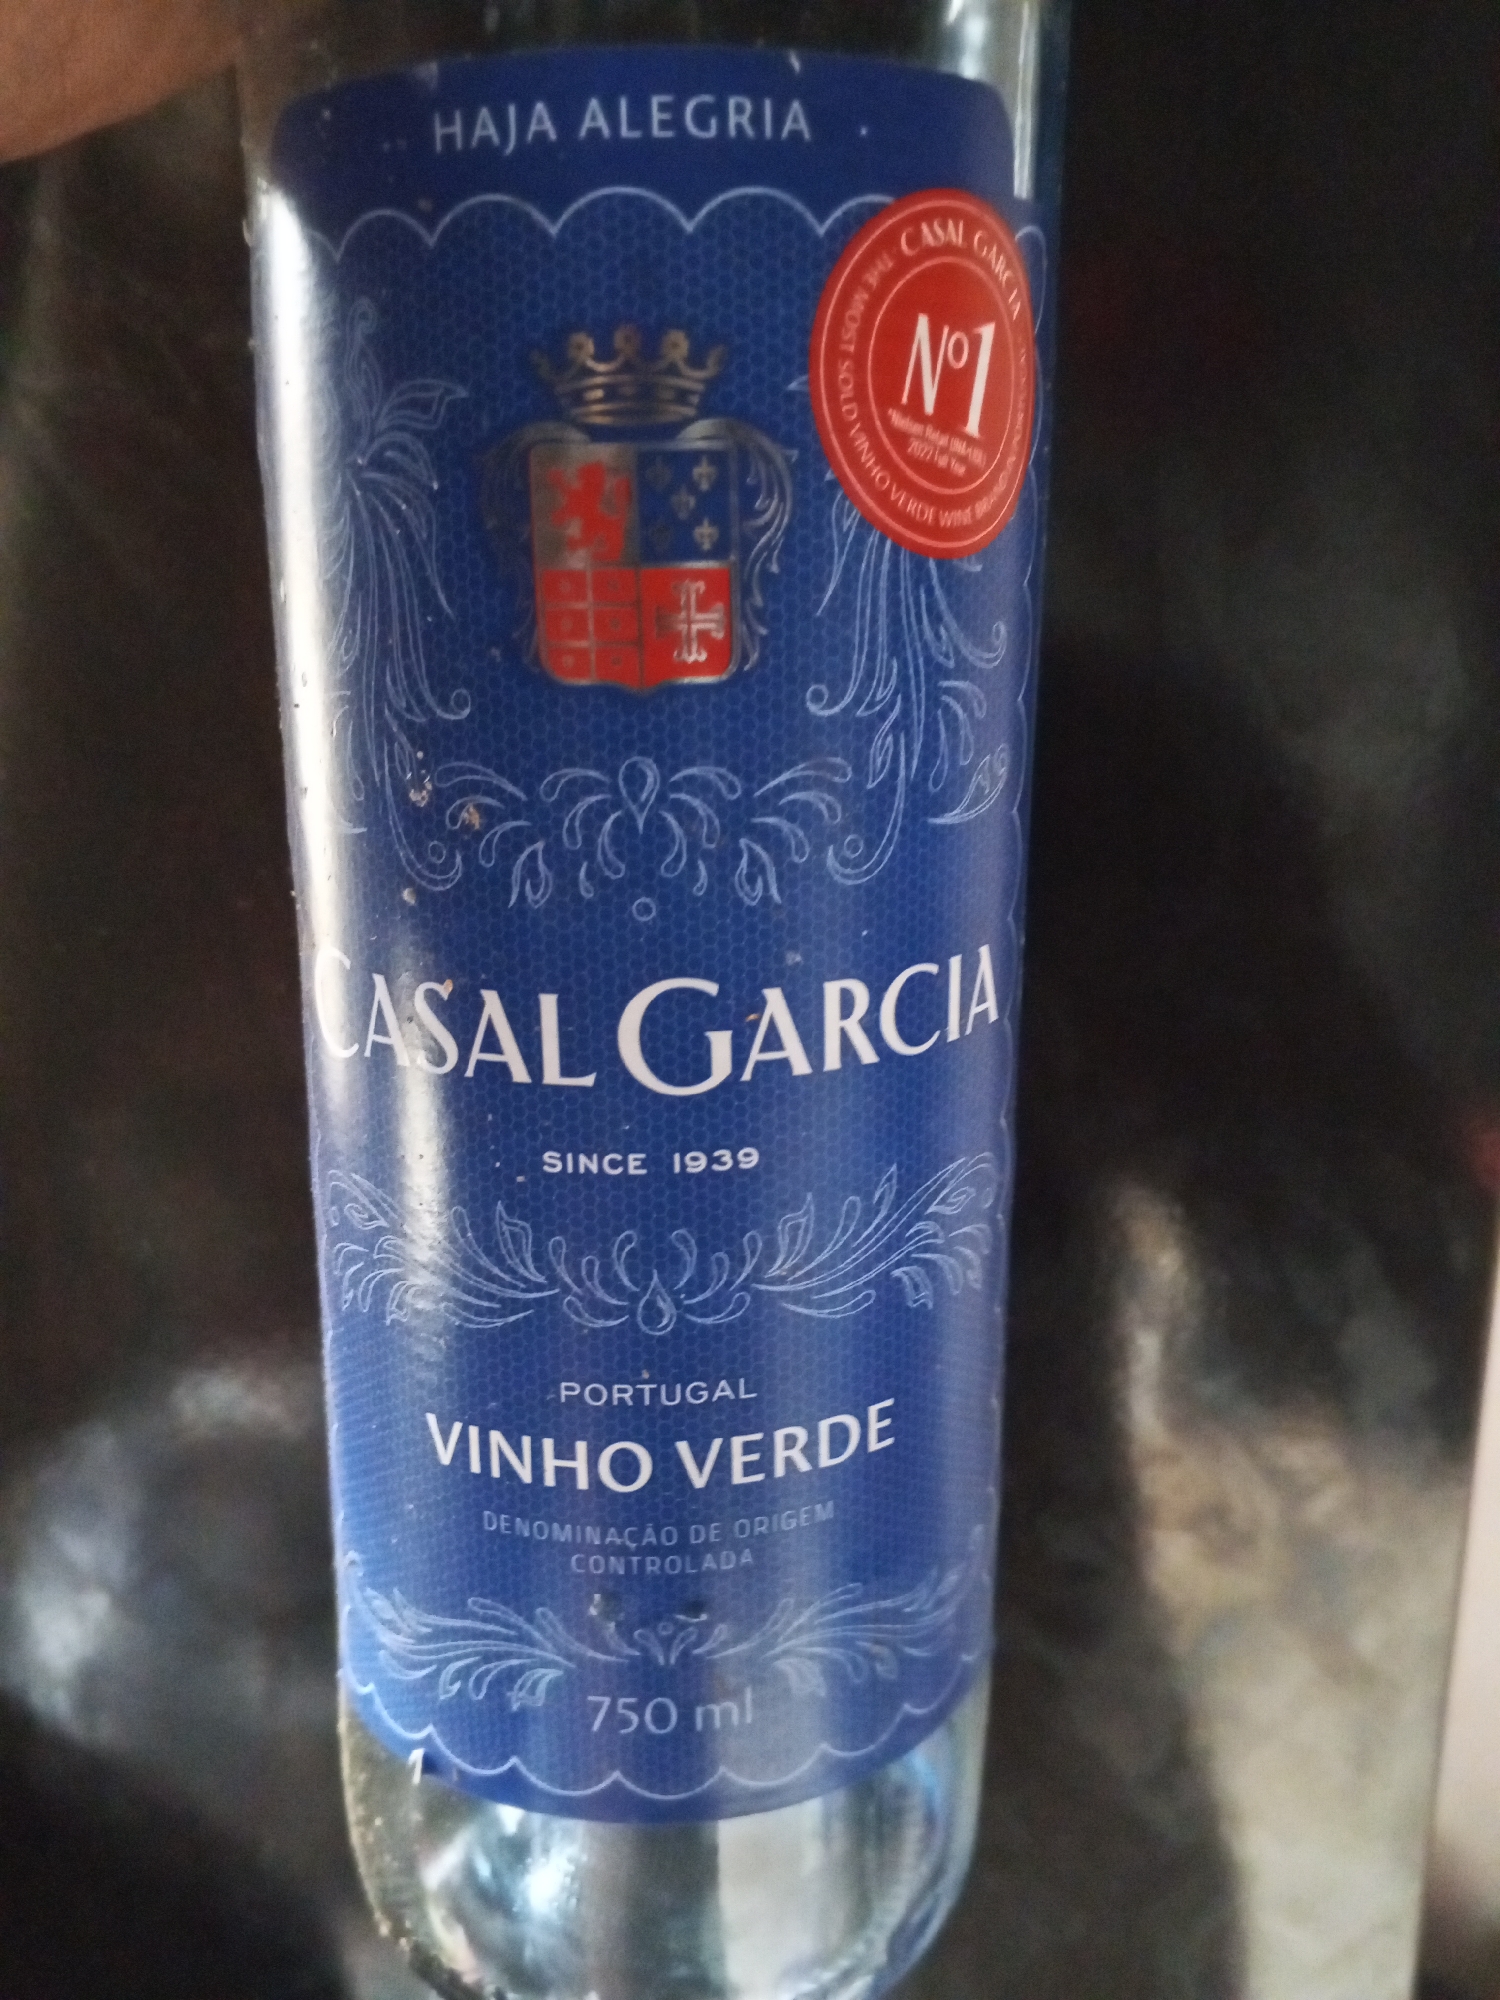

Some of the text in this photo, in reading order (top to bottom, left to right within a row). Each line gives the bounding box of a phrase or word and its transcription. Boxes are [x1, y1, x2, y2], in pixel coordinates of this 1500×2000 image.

[434, 94, 811, 155] HAJA ALEGRIA
[900, 218, 967, 256] CASAL
[838, 358, 858, 421] SOLD
[850, 422, 890, 491] VINHO
[314, 944, 1000, 1096] CASAL GARCIA
[542, 1147, 760, 1175] SINCE 1939
[560, 1378, 757, 1406] PORTUGAL
[425, 1397, 895, 1493] VINHO VERDE
[482, 1500, 836, 1550] DENOMINAÇÃO DE ORIGEM
[570, 1548, 754, 1575] CONTROLADA
[586, 1686, 753, 1734] 750 ml
